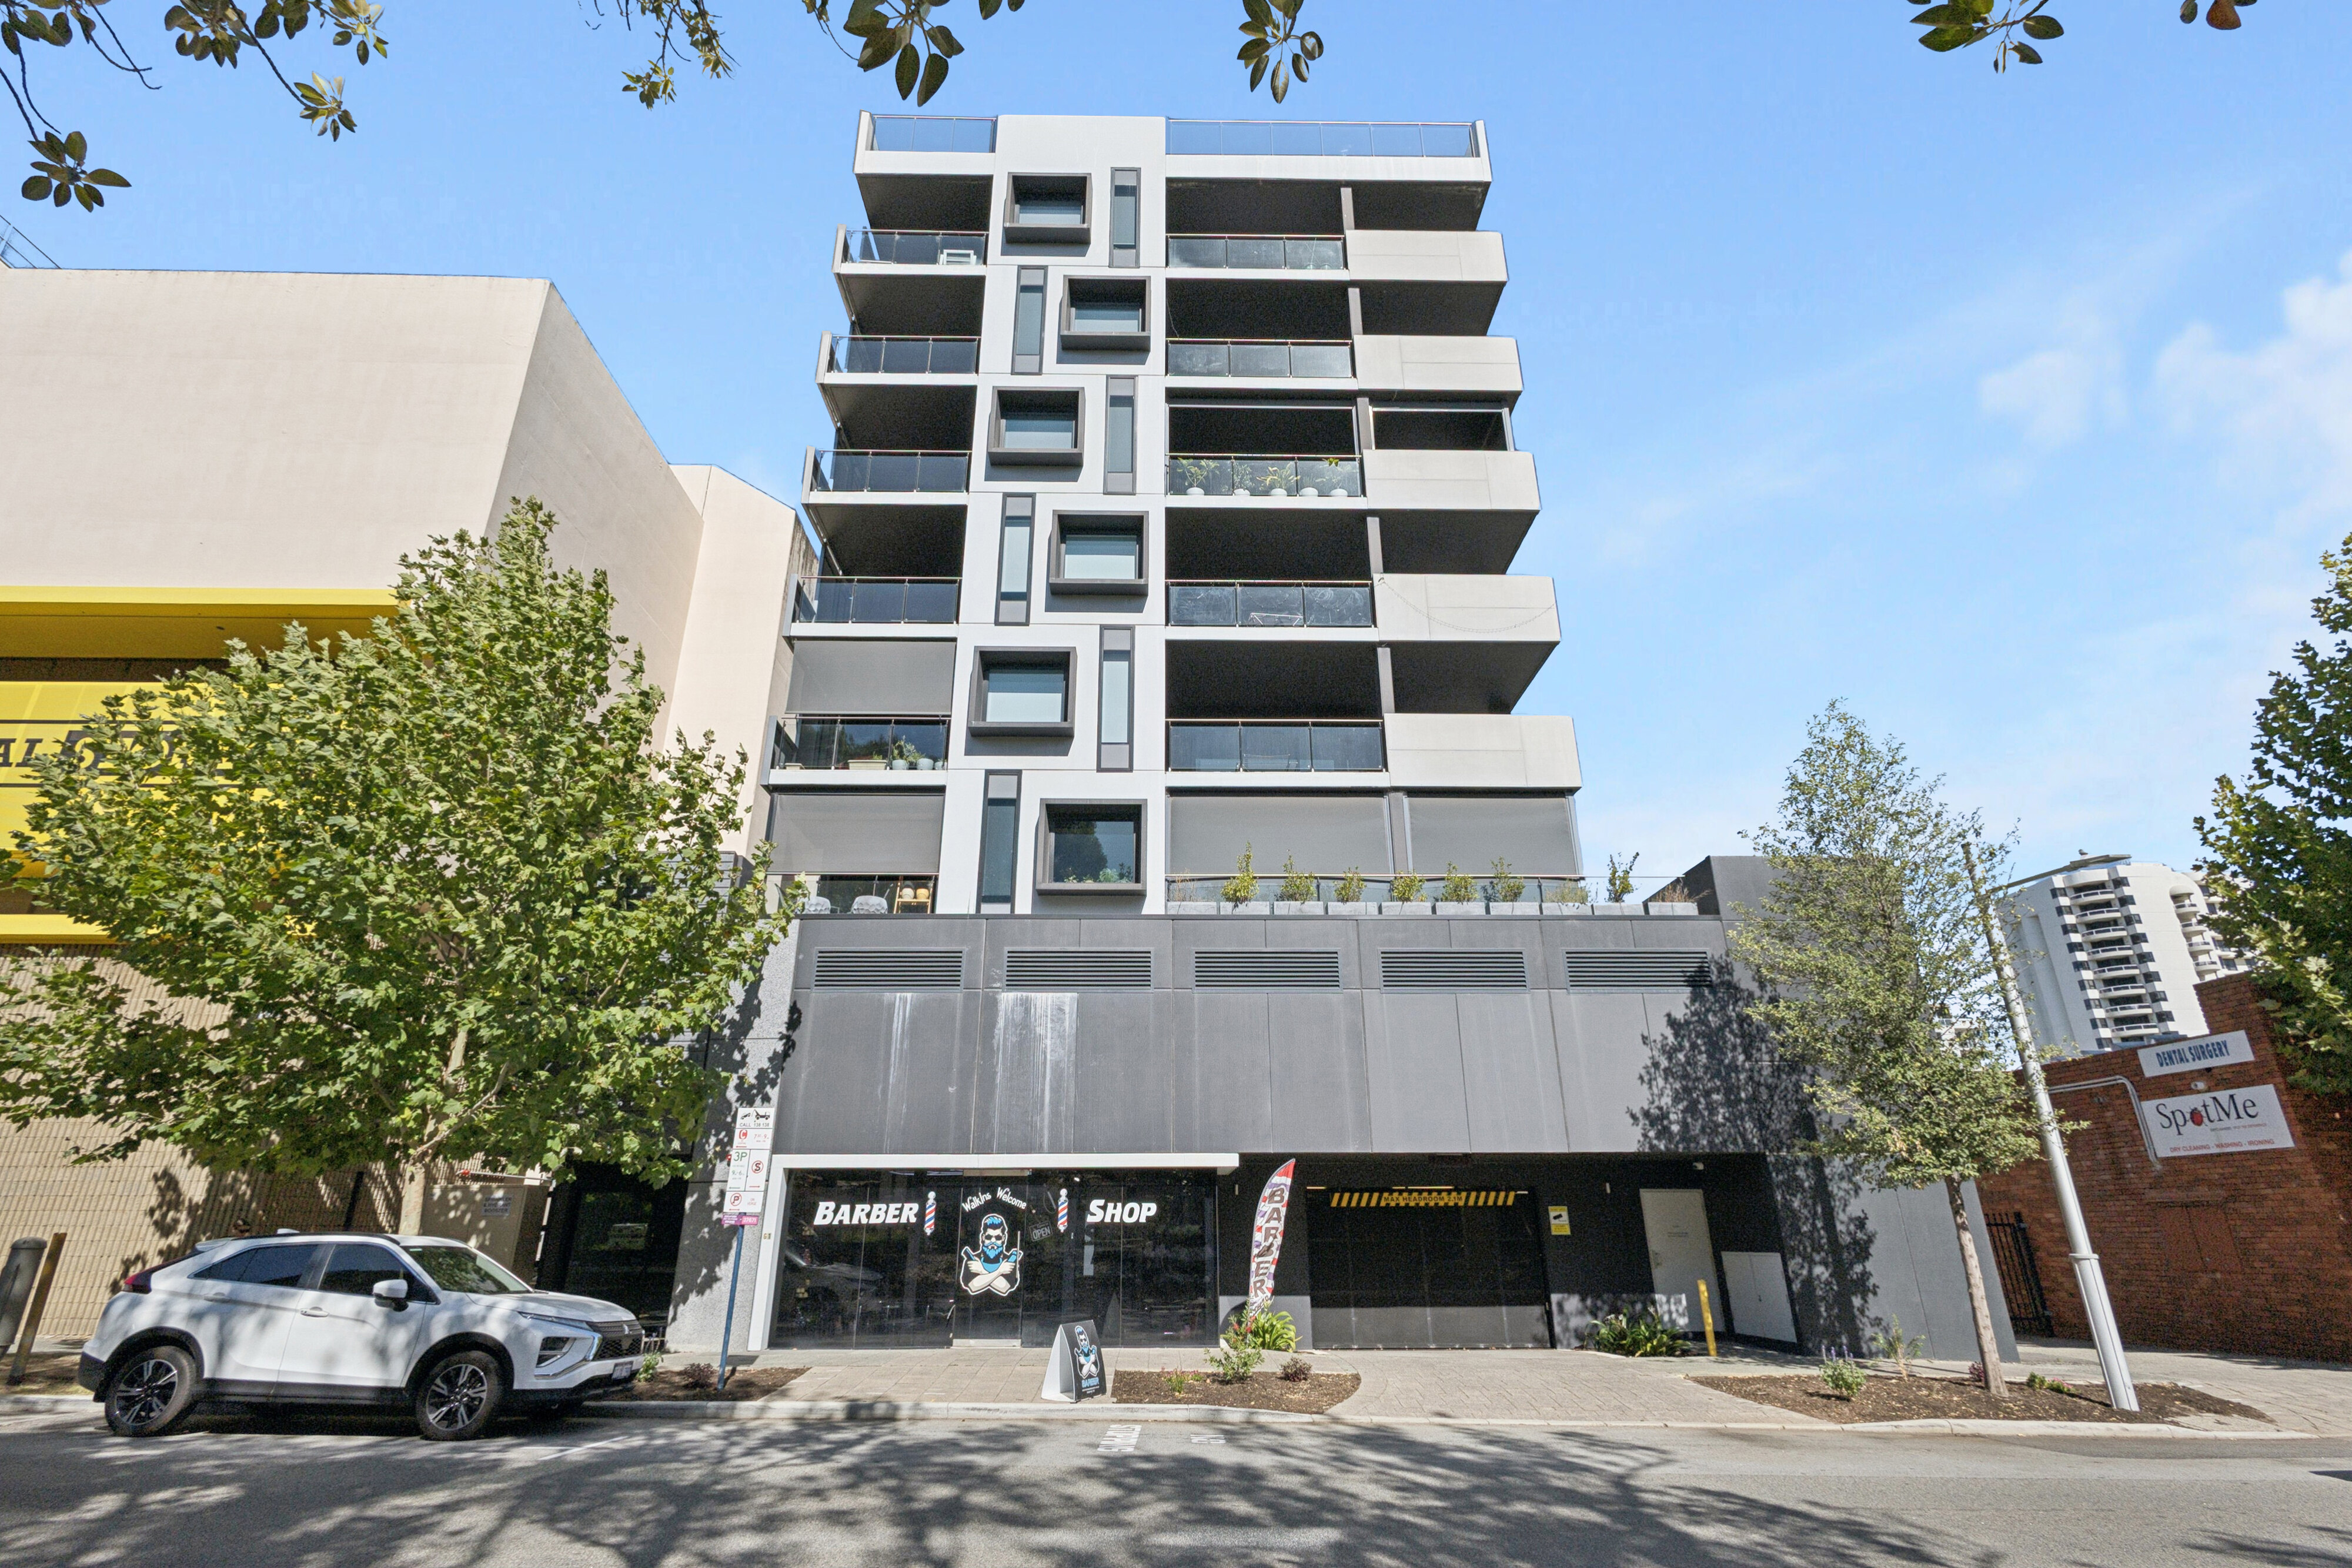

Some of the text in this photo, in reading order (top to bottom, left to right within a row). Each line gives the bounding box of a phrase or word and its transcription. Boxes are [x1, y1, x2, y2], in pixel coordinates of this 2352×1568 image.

[2156, 1040, 2230, 1067] DENTAL SURGERY
[733, 1152, 747, 1161] 3P
[997, 1187, 1027, 1209] Welcome
[813, 1201, 919, 1225] BARBER
[1087, 1199, 1157, 1223] SHOP
[1033, 1226, 1051, 1239] OPEN
[1253, 1188, 1285, 1298] BARBER
[1097, 1424, 1142, 1452] STOPPING
